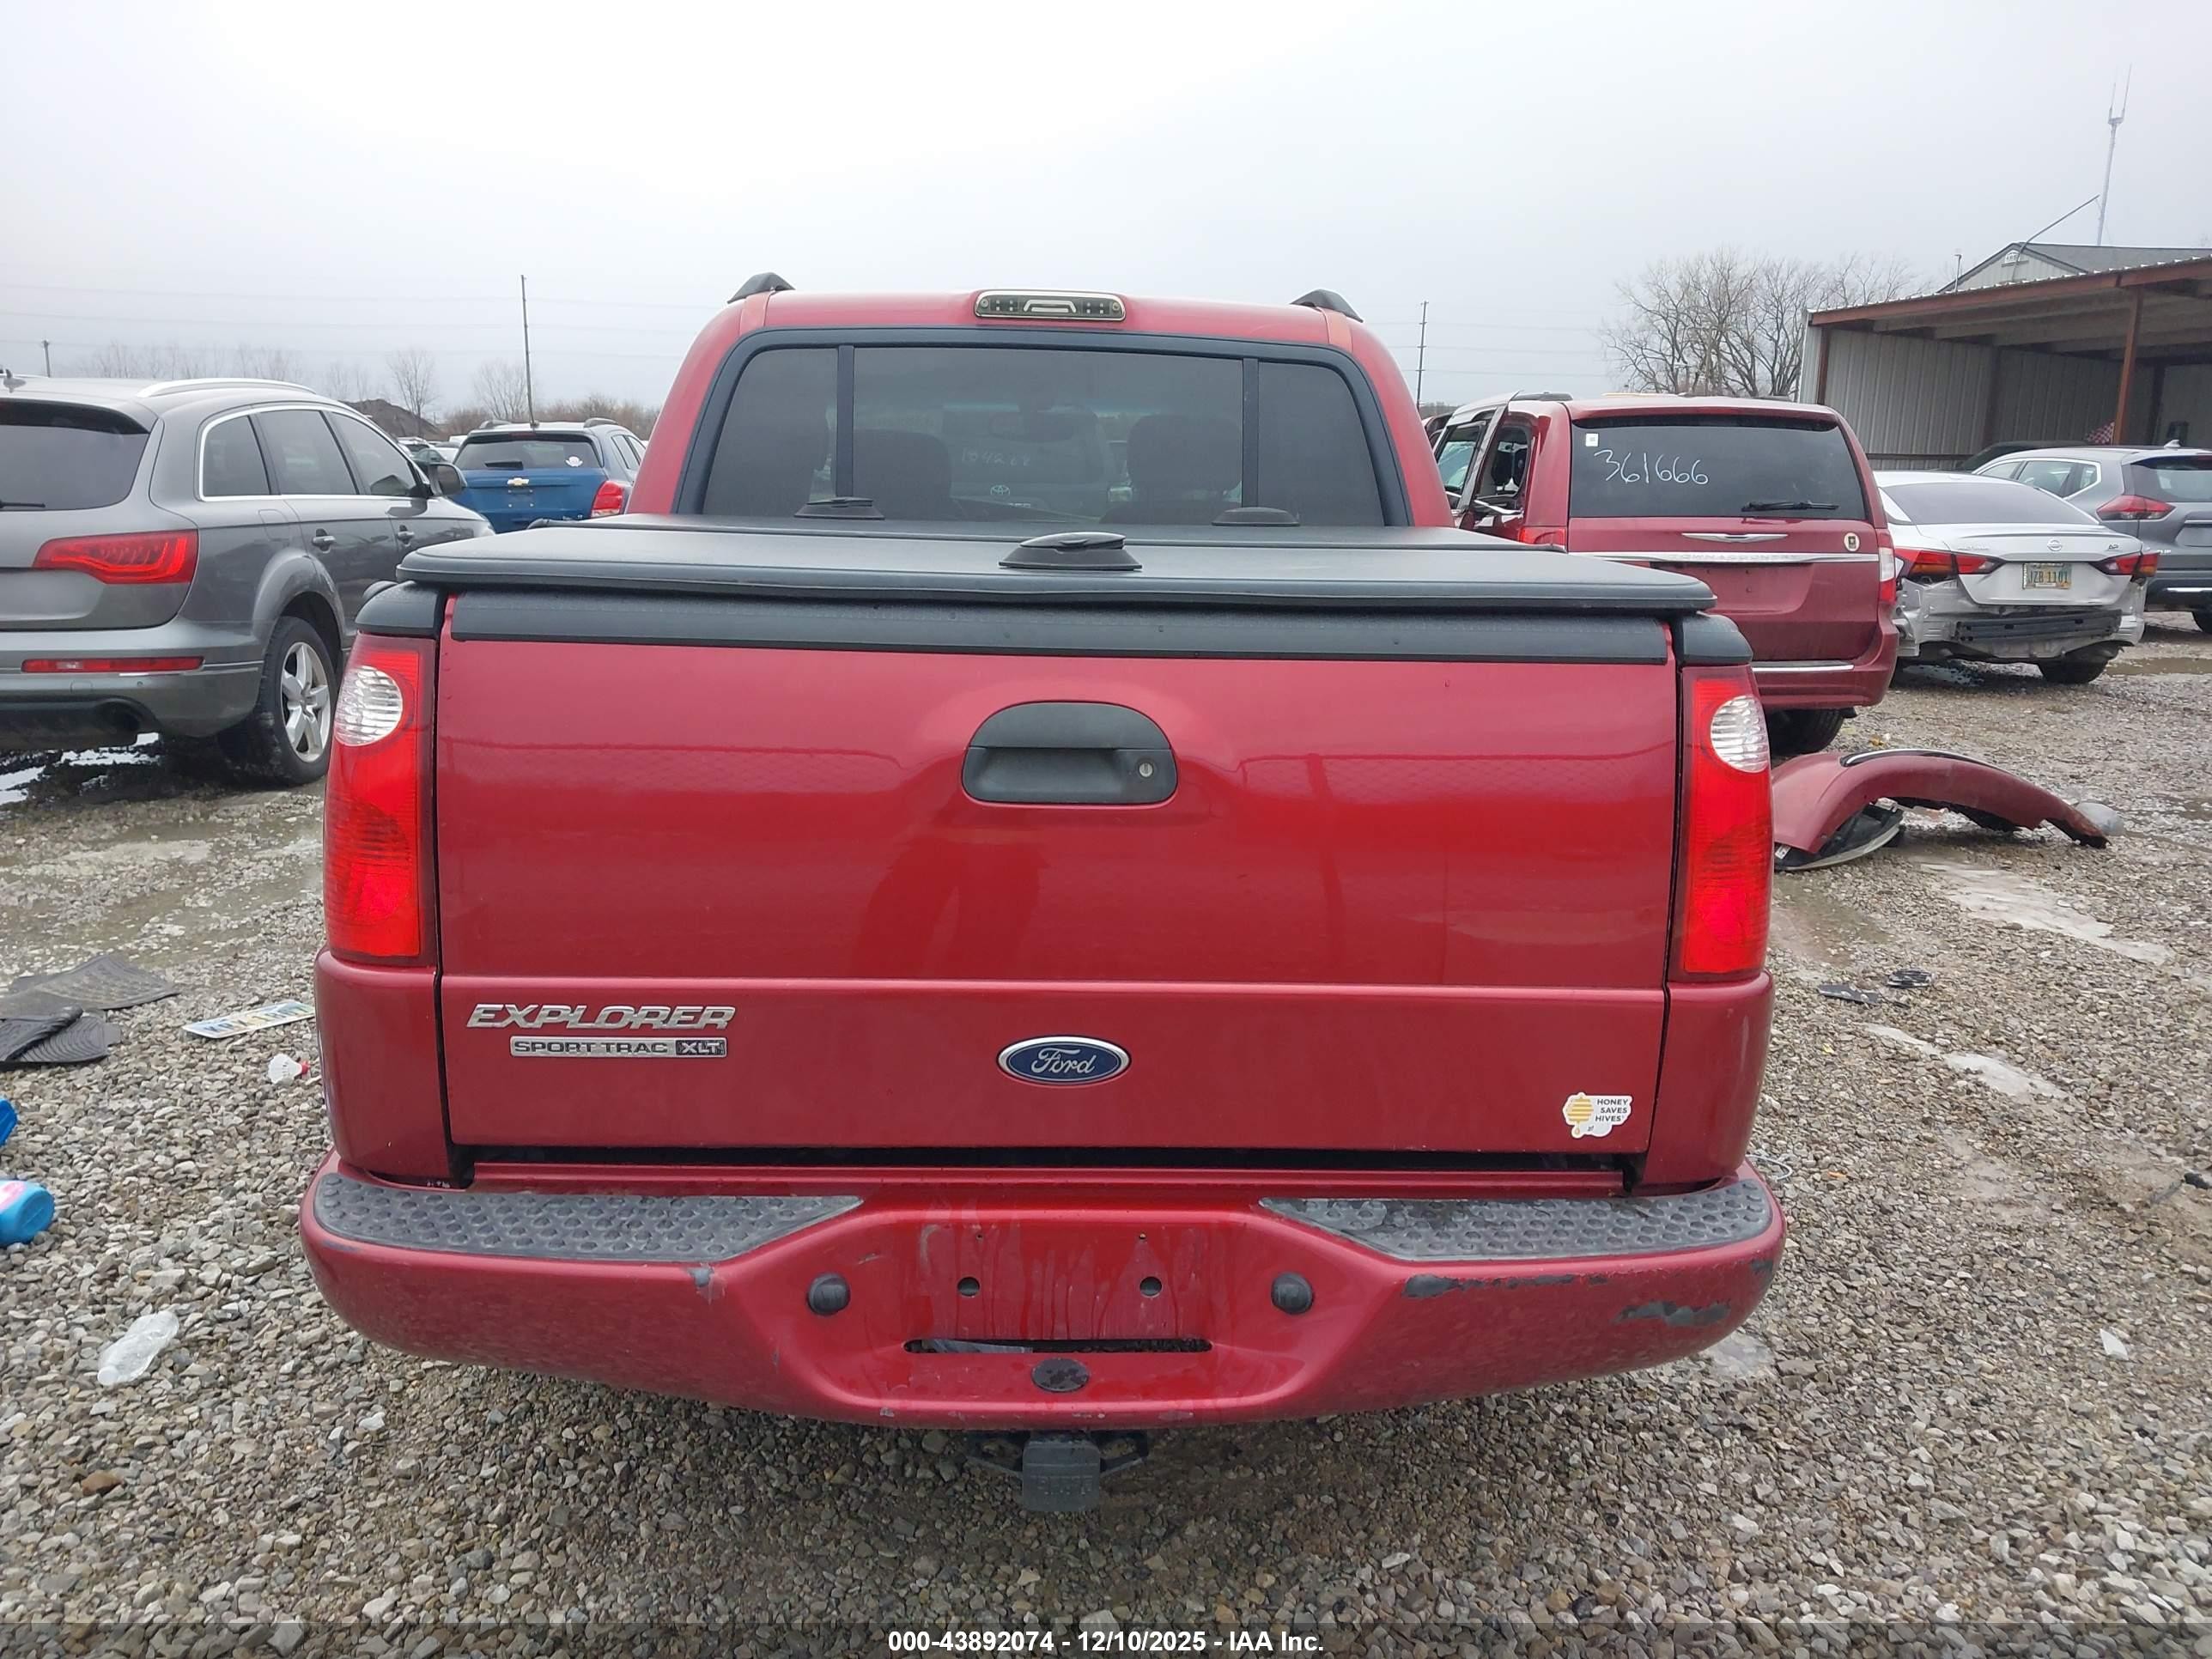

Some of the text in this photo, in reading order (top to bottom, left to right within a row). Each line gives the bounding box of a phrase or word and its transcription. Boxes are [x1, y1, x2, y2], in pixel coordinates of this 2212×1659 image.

[1594, 449, 1709, 484] 361666
[466, 1004, 735, 1030] EXPLORER
[514, 1042, 723, 1054] SPORT TRAC XLT
[1031, 1048, 1097, 1074] Ford
